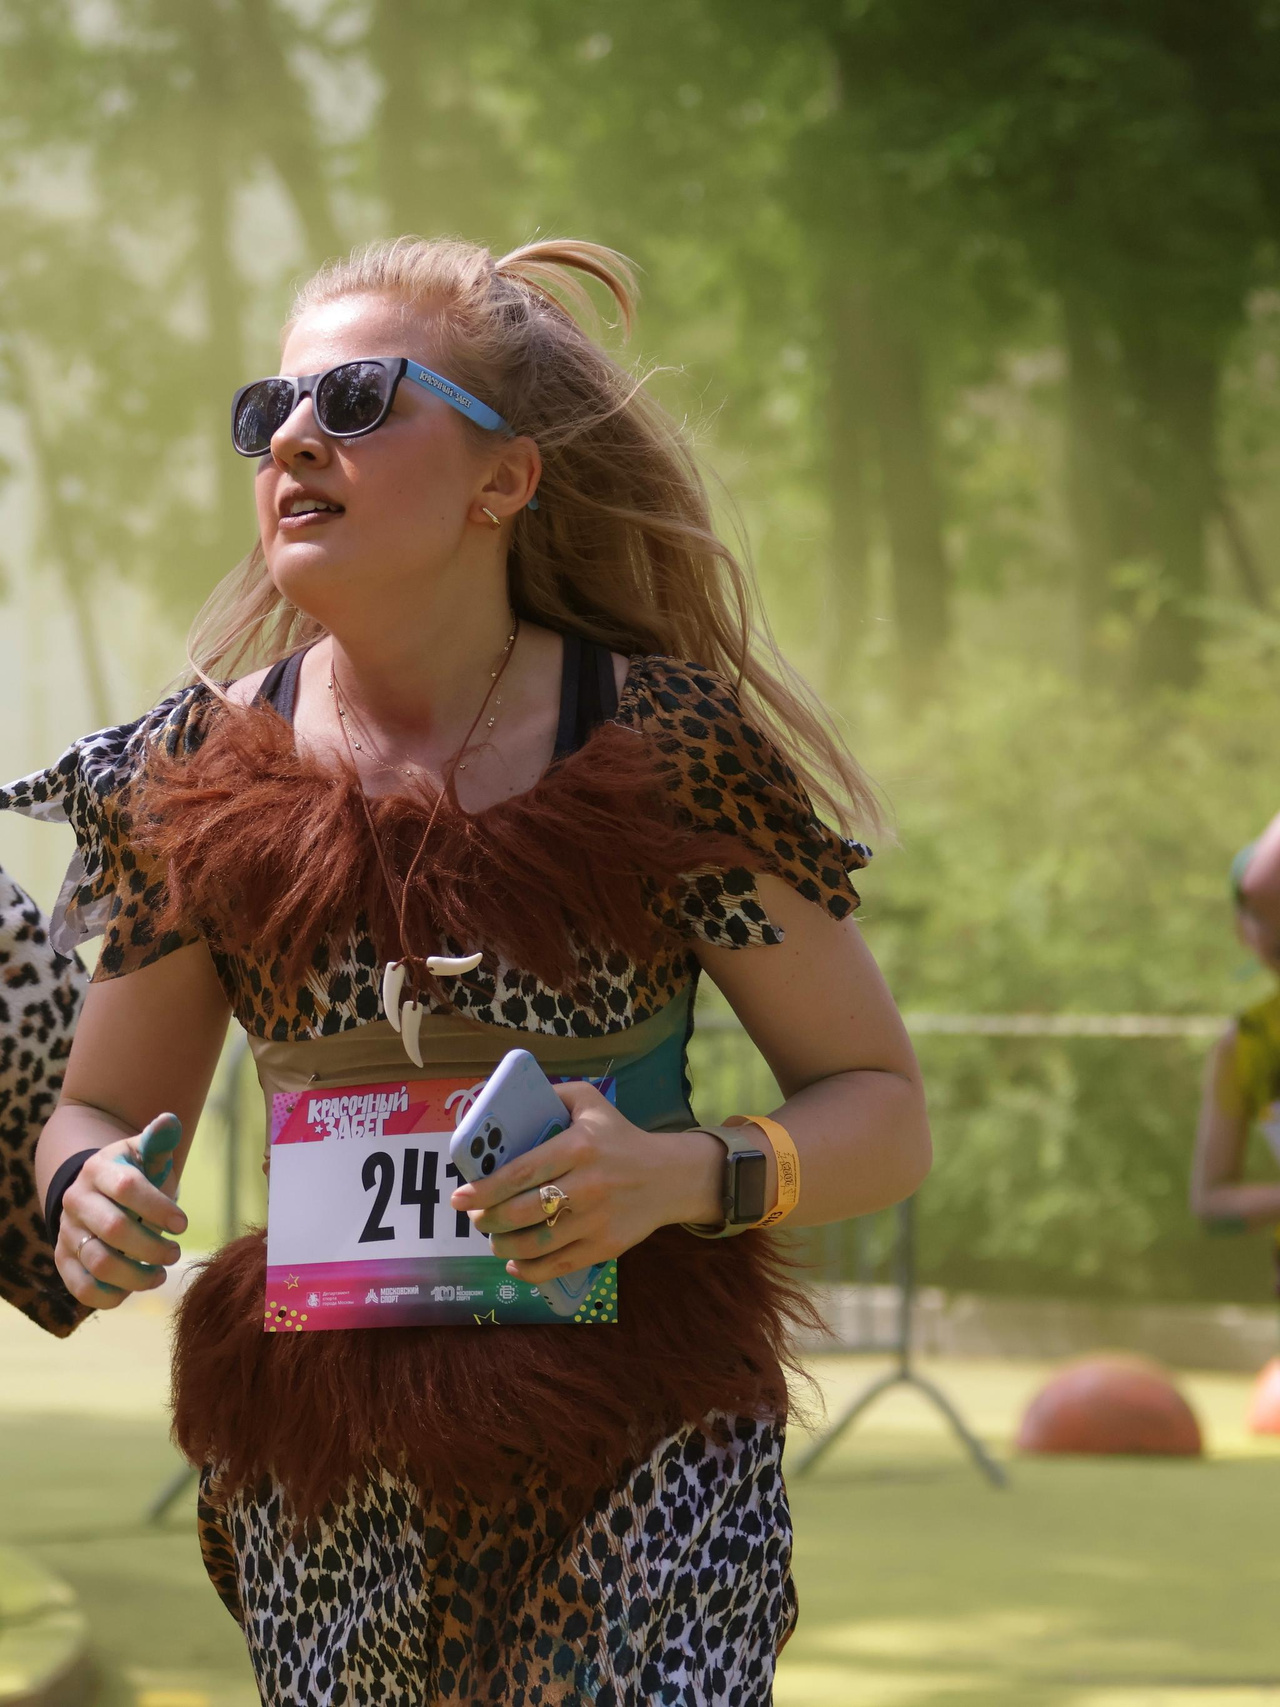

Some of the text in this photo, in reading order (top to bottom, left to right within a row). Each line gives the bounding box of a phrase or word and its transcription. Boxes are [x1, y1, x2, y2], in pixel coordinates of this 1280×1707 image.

[307, 1085, 409, 1124] КРАСОЧНЫЙ
[323, 1111, 390, 1141] ЗАБЕГ
[358, 1148, 489, 1243] 241
[380, 1285, 419, 1296] МОСКОВСКИЙ
[380, 1295, 399, 1304] СПОРТ
